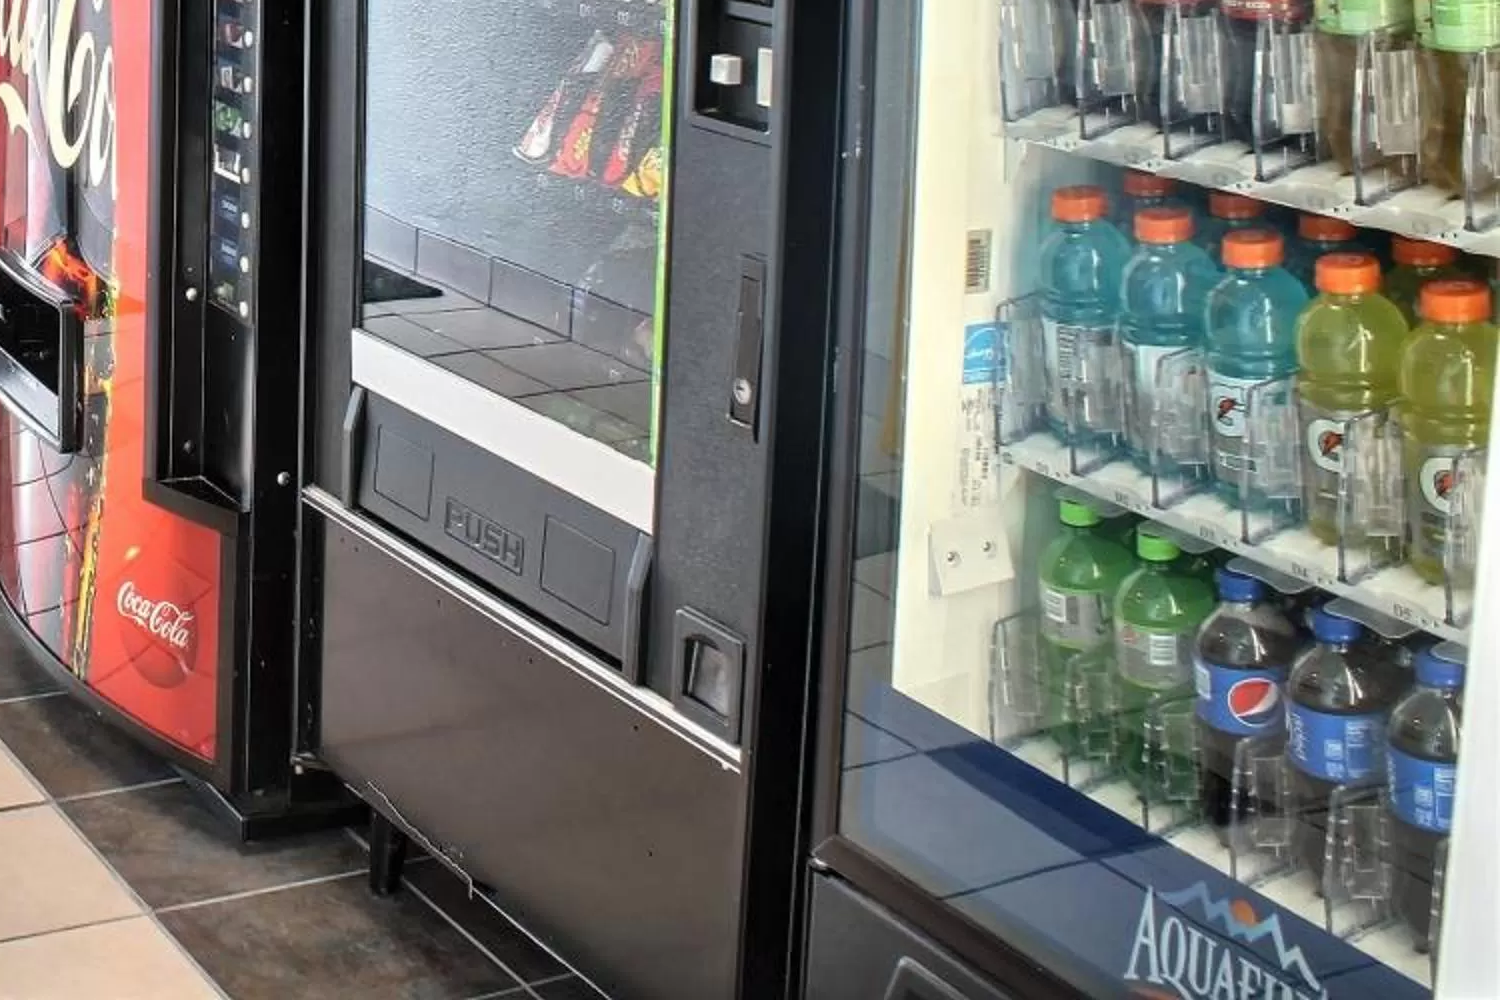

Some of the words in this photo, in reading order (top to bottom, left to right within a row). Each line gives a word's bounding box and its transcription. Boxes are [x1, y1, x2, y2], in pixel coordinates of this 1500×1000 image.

[445, 499, 521, 569] PUSH
[117, 581, 194, 648] Coca-Cola
[1123, 885, 1330, 1000] AQUAF
